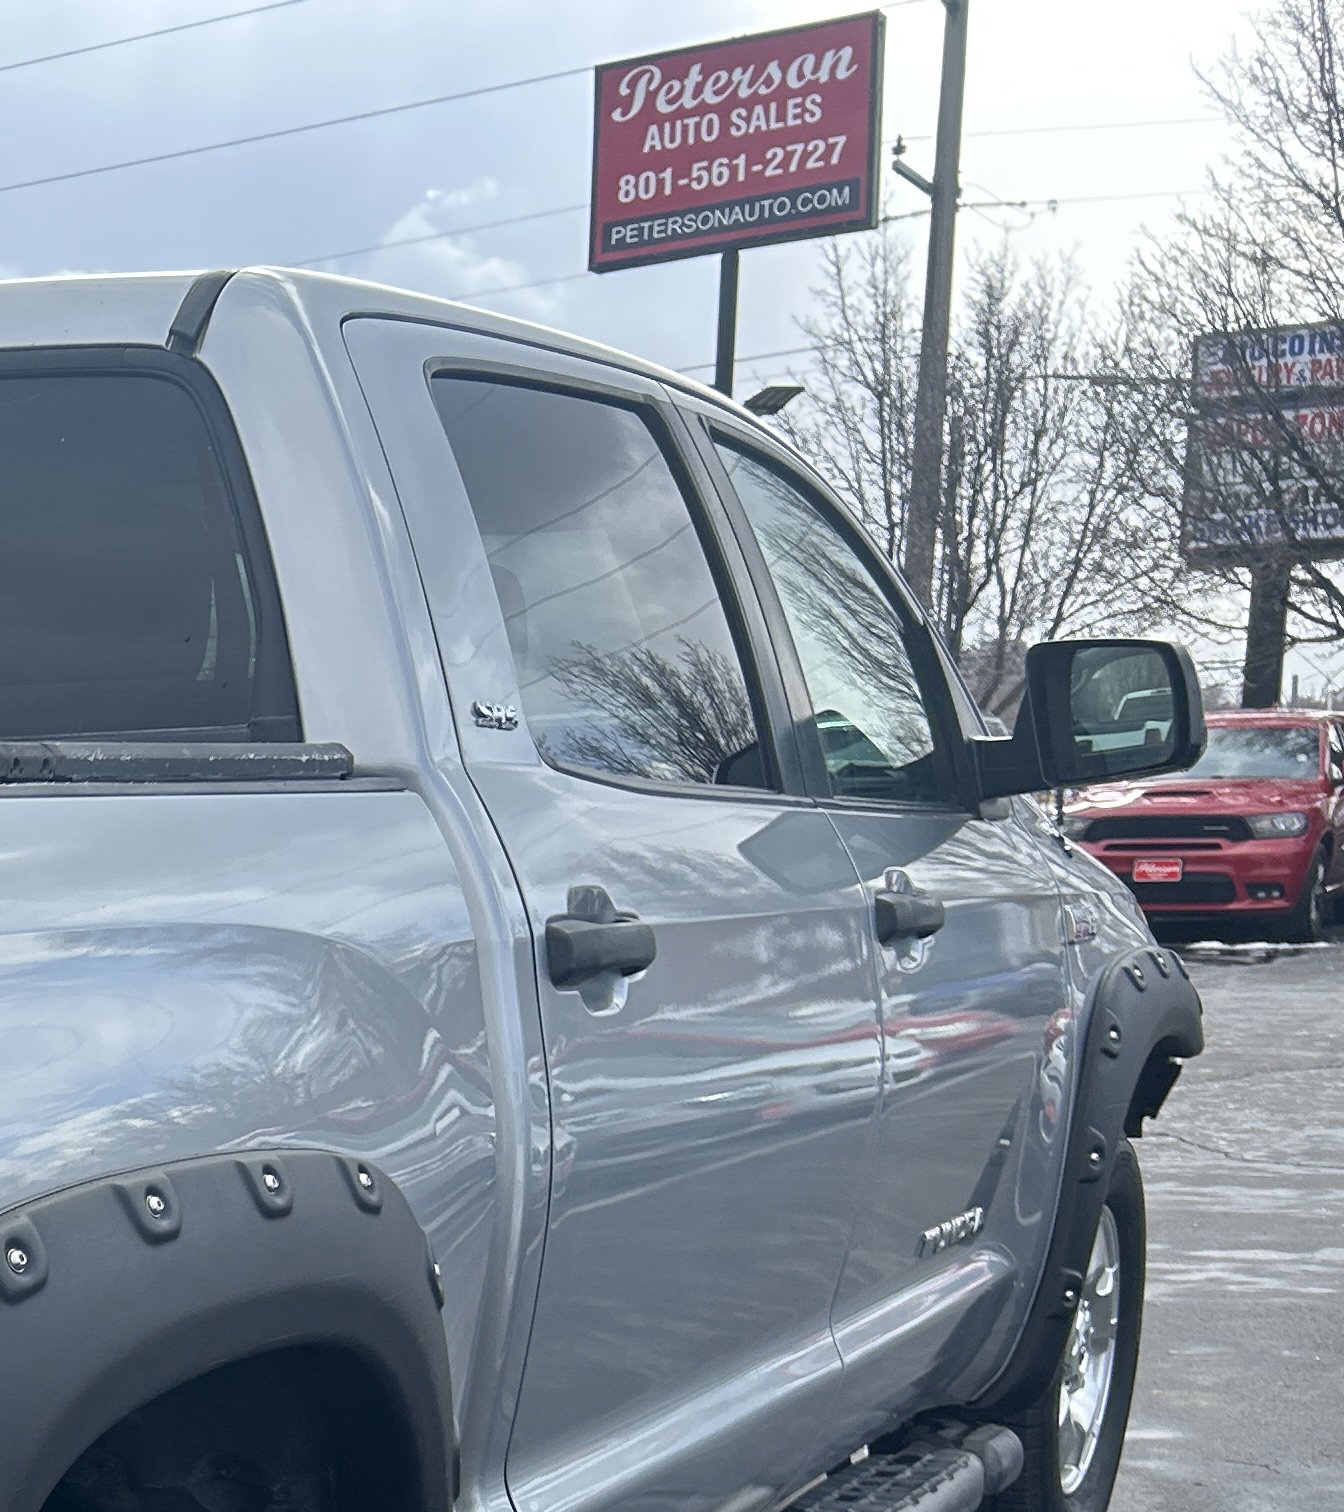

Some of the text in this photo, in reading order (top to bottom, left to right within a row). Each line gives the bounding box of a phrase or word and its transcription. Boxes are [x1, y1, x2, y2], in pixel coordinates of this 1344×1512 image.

[610, 45, 859, 123] Peterson
[642, 93, 822, 153] AUTO SALES
[617, 134, 847, 204] 801-561-2727
[610, 185, 850, 246] PETERSONAUTO.COM
